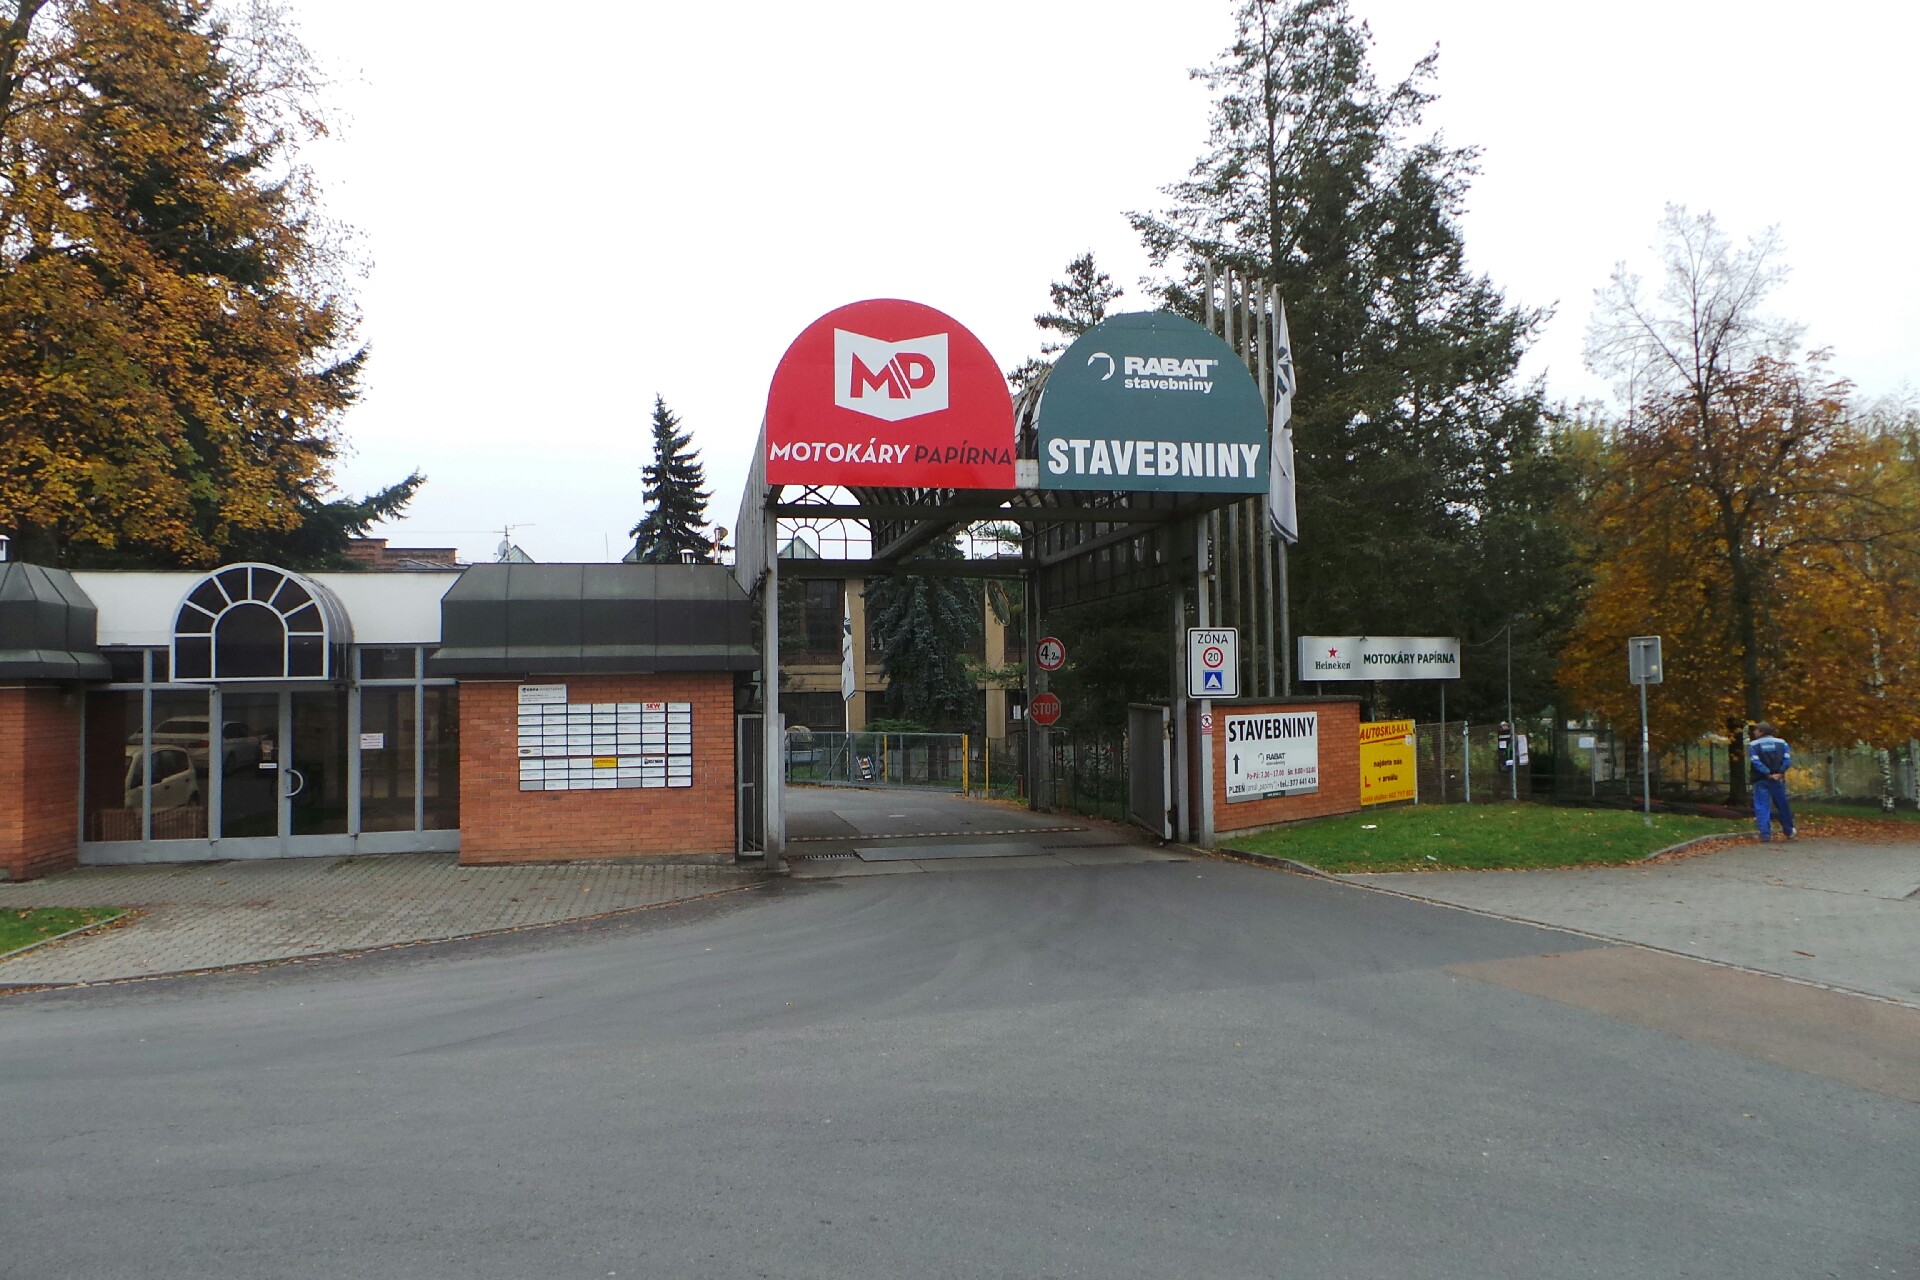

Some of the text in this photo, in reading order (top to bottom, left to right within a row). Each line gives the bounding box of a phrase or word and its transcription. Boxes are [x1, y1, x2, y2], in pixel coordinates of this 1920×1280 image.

[1124, 356, 1213, 378] RABAT
[1124, 377, 1214, 394] stavebniny
[769, 437, 1013, 466] MOTOKÁRY PAPÍRNA
[1048, 437, 1262, 479] STAVEBNINY
[1197, 632, 1229, 645] ZÓNA
[1207, 652, 1219, 662] 20
[1363, 650, 1456, 665] MOTOKÁRY PAPÍRNA
[1315, 661, 1352, 671] Heineken
[1032, 702, 1059, 715] STOP
[1228, 716, 1316, 743] STAVEBNINY
[1266, 752, 1286, 761] RABAT
[1229, 783, 1246, 794] PLZEŇ
[1289, 778, 1299, 787] 377
